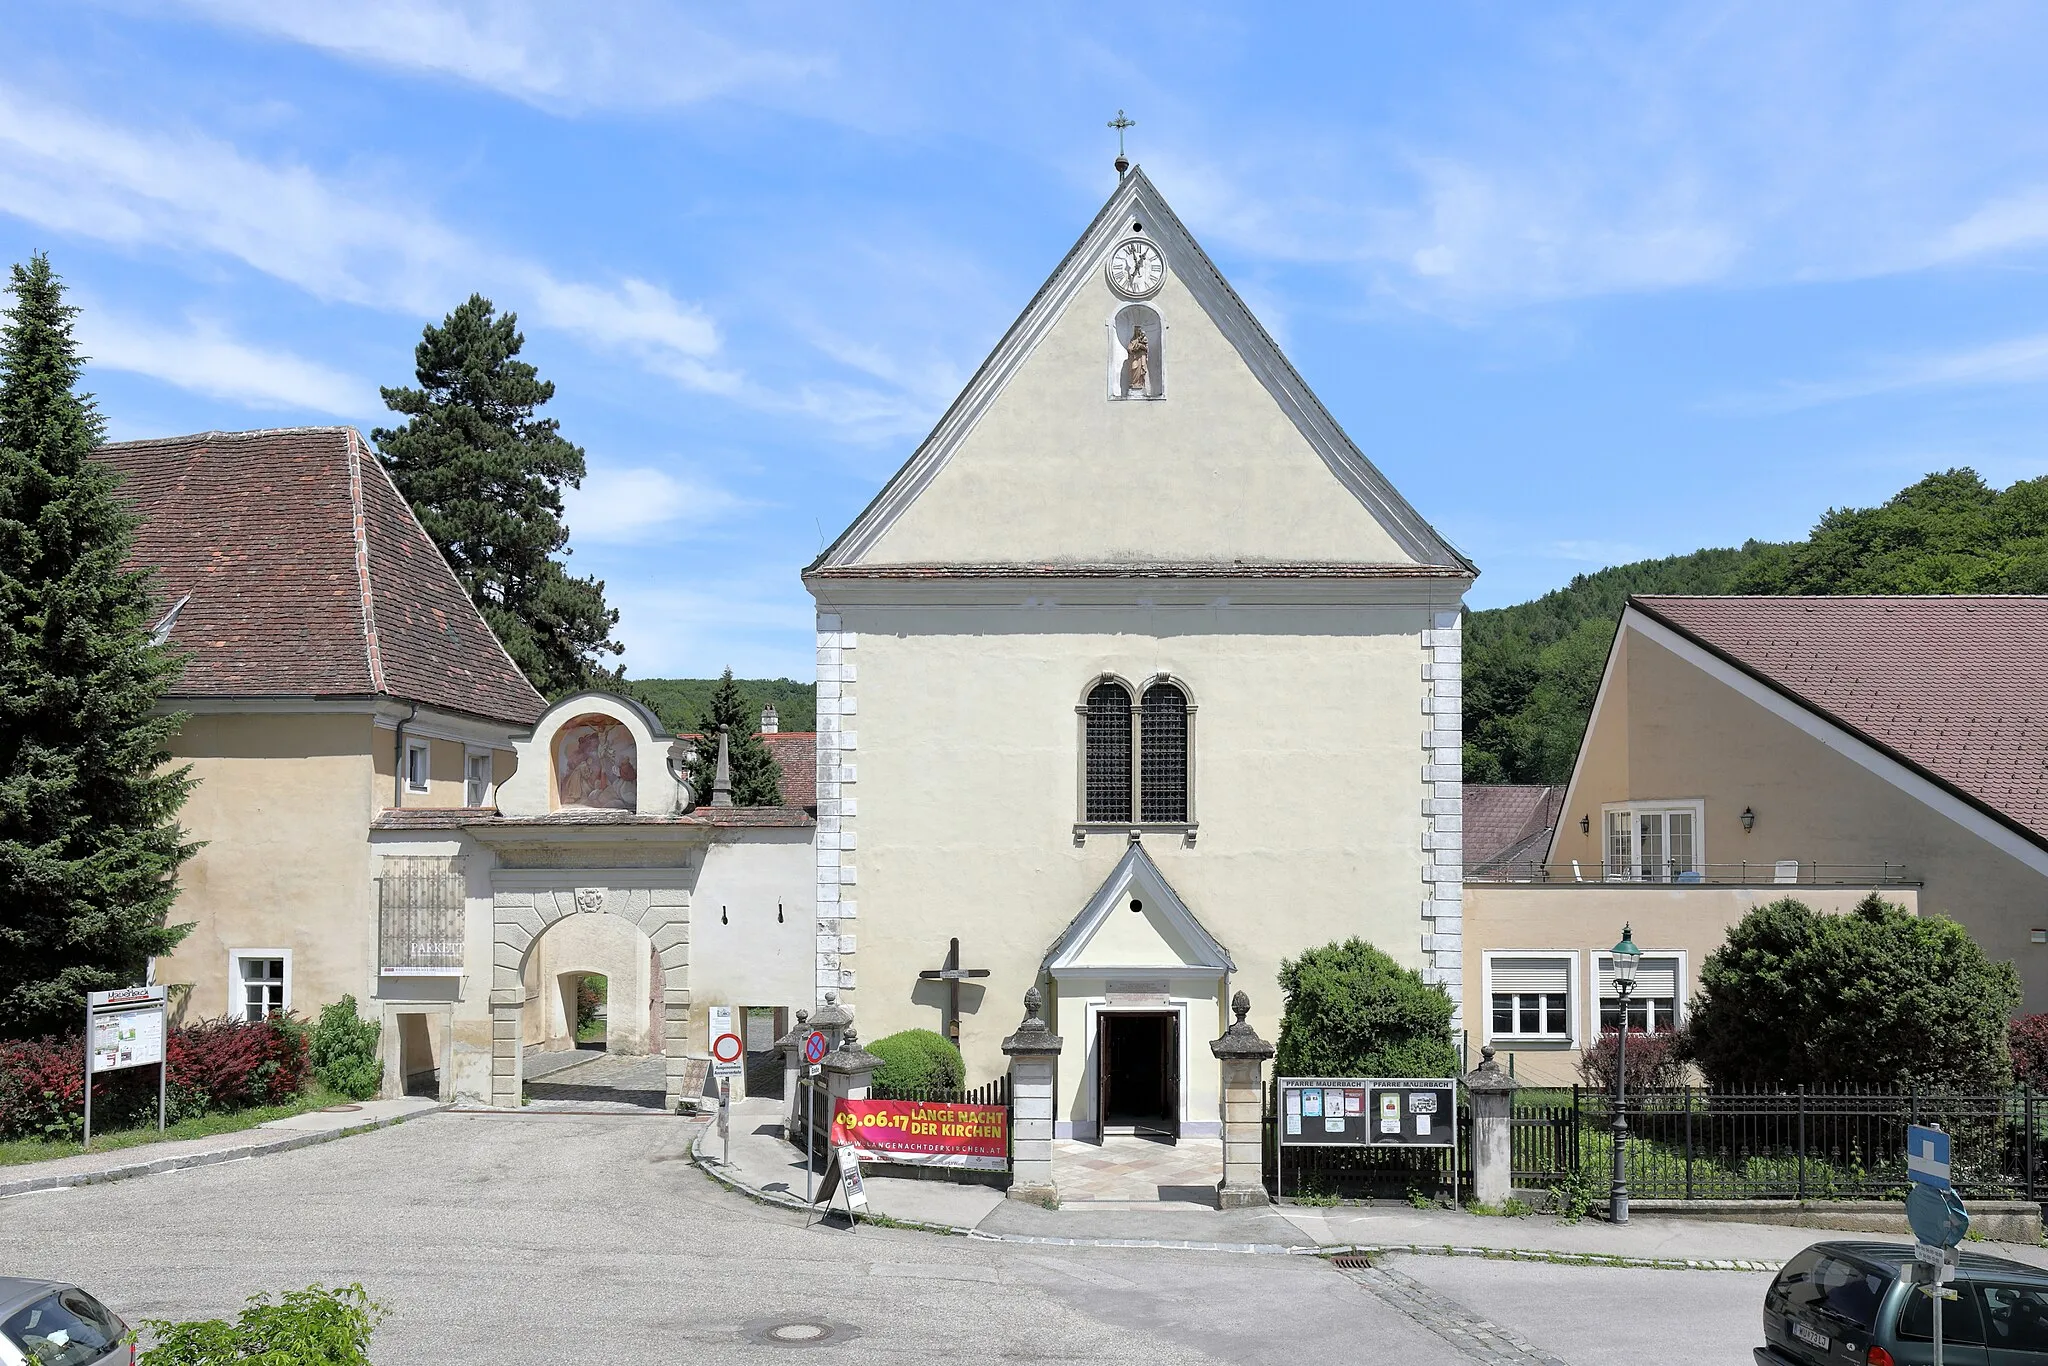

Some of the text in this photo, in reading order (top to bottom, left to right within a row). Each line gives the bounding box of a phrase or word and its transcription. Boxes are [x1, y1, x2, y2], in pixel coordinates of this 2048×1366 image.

[411, 943, 464, 953] PARKETT
[108, 988, 149, 999] Mauerbach
[836, 1110, 909, 1131] 09.06.17
[911, 1108, 1003, 1124] LANGE NACHT
[911, 1122, 1002, 1138] DER KIRCHEN
